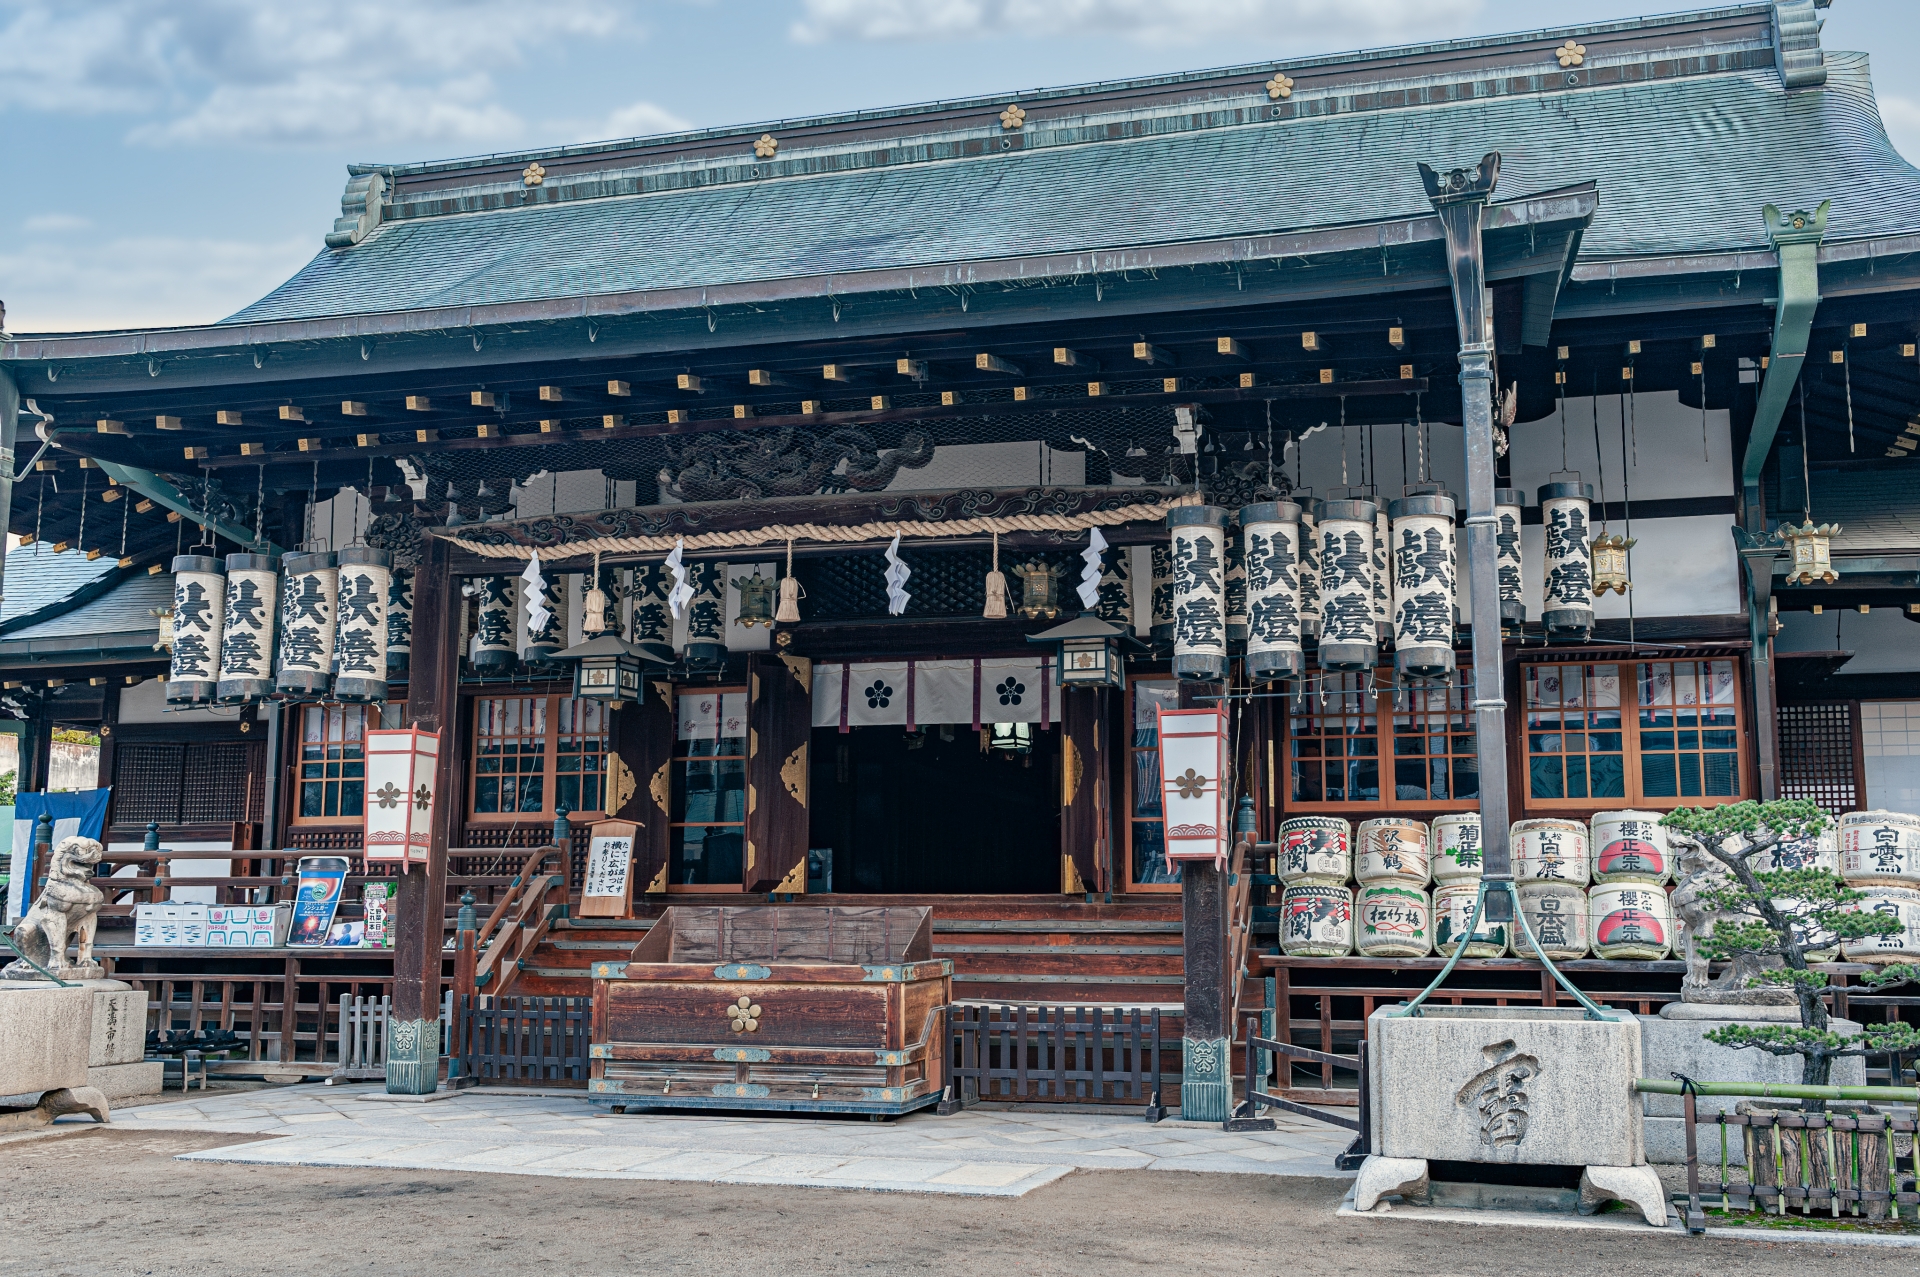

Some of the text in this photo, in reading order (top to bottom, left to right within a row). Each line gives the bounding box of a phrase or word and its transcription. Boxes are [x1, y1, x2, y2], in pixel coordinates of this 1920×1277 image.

[597, 841, 611, 892] お参りください
[606, 841, 622, 892] 横に広がって
[615, 841, 629, 893] たてに並ばず
[1288, 829, 1336, 873] 大関
[1383, 829, 1403, 870] 沢の鶴
[1459, 825, 1481, 868] 菊正宗
[1536, 839, 1565, 878] 白鹿
[1618, 822, 1641, 870] 櫻正宗
[1869, 825, 1904, 874] 白鷹
[1290, 898, 1339, 941] 大関
[1370, 906, 1420, 927] 松竹梅
[1536, 899, 1567, 946] 日本盛
[1617, 891, 1641, 940] 櫻正宗
